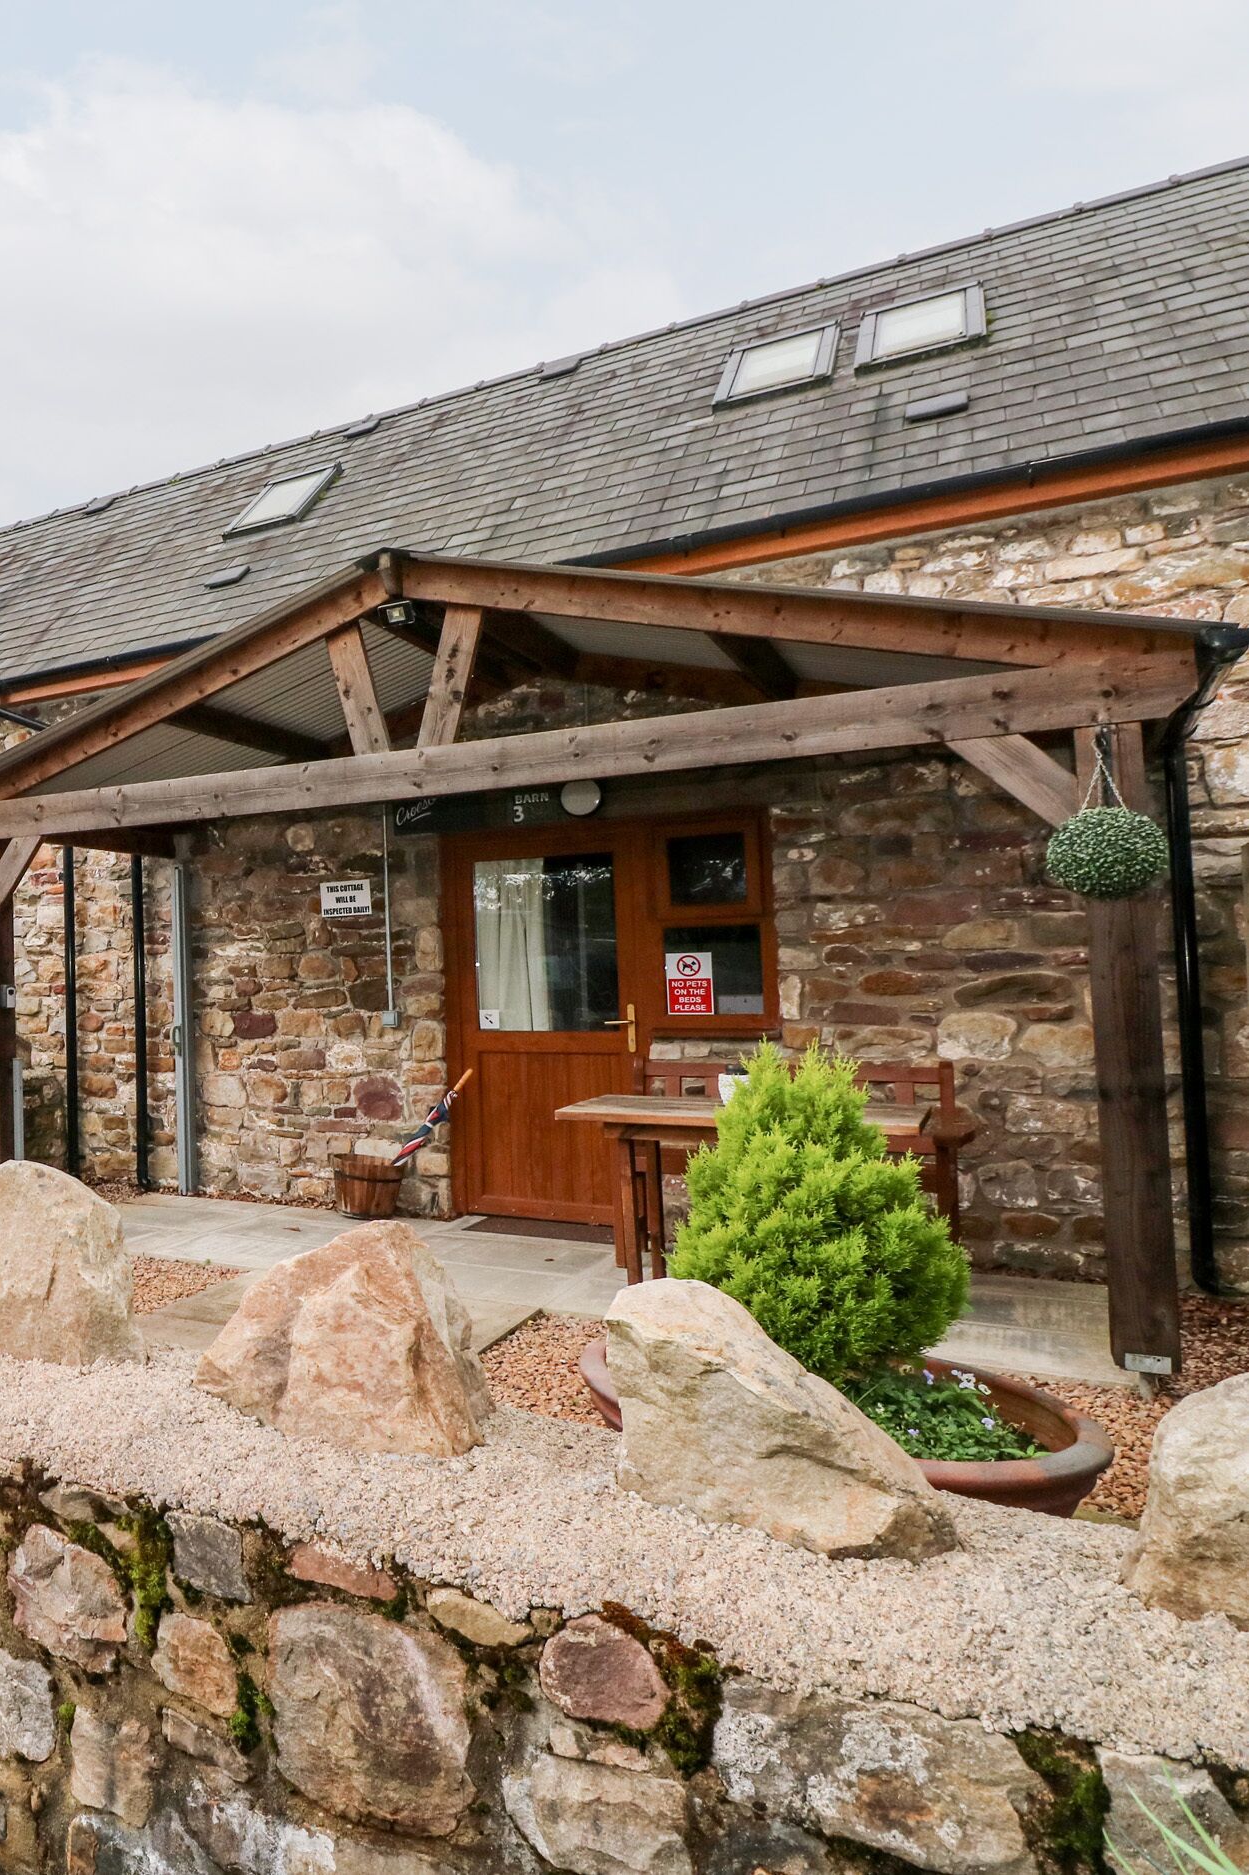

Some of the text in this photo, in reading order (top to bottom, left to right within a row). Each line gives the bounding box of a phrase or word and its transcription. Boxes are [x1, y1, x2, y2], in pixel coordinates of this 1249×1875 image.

[515, 792, 549, 804] BARN
[513, 806, 525, 822] 3
[326, 884, 364, 893] THIS COTTAGE
[335, 895, 356, 904] WILL BE
[323, 907, 353, 916] INSPECTED
